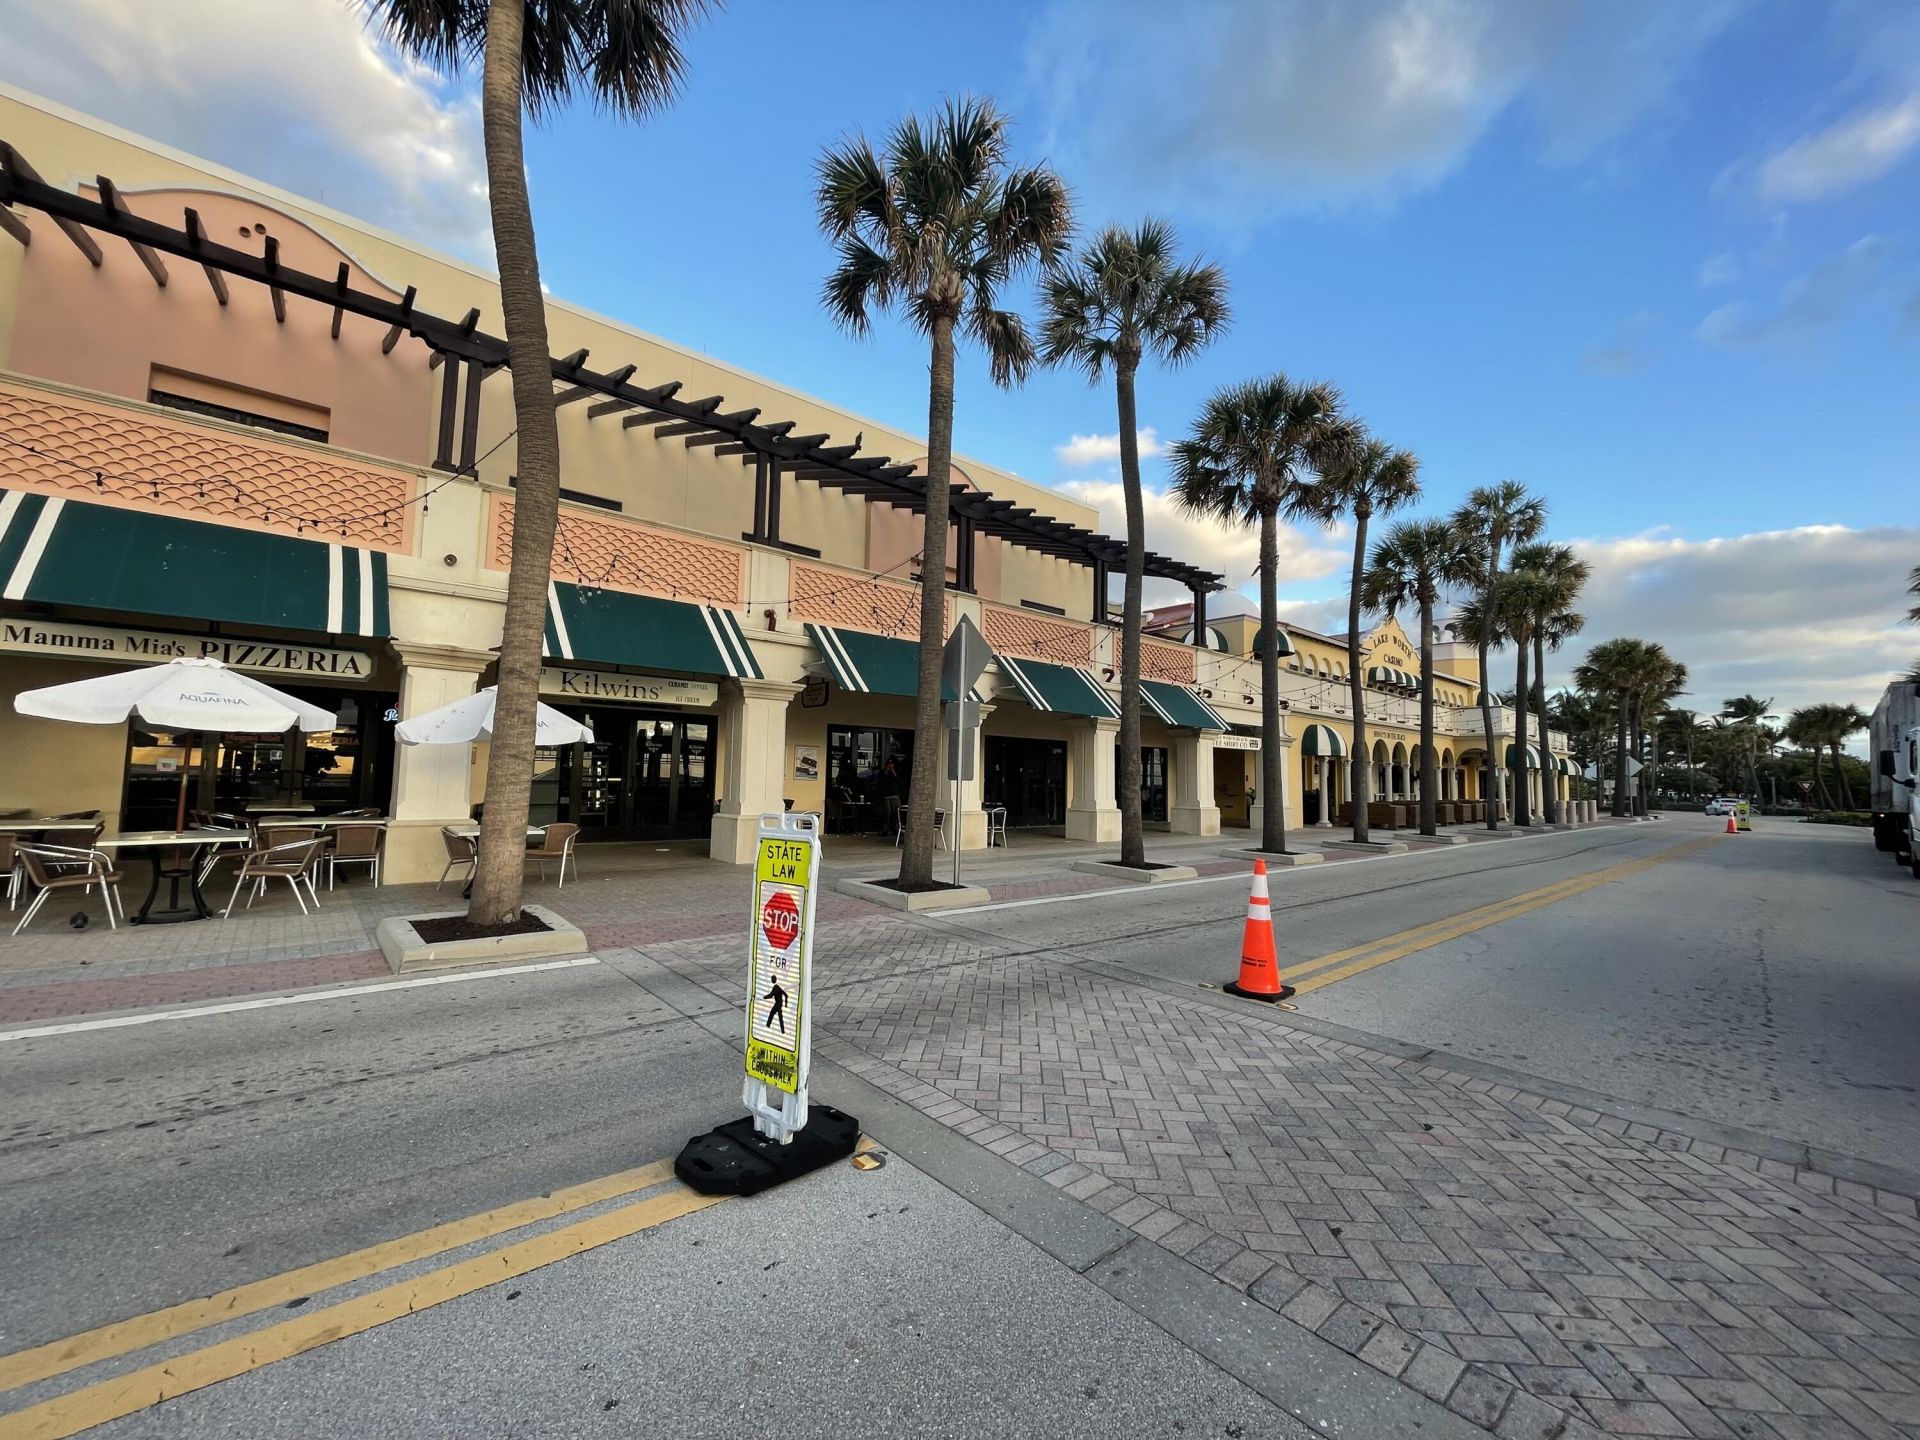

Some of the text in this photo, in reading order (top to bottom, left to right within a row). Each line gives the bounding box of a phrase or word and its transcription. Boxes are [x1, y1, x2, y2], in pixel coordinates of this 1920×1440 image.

[3, 625, 362, 675] Mamma Mia's PIZZERIA
[1373, 634, 1412, 660] LAKE WORTH
[1384, 654, 1404, 667] CASINO
[179, 693, 250, 706] AQUAFINA
[767, 845, 802, 862] STATE
[772, 863, 796, 879] LAW
[763, 909, 799, 932] STOP
[769, 955, 787, 969] FOR
[758, 1047, 786, 1066] WITHIN
[751, 1059, 793, 1086] CROSSWALK
